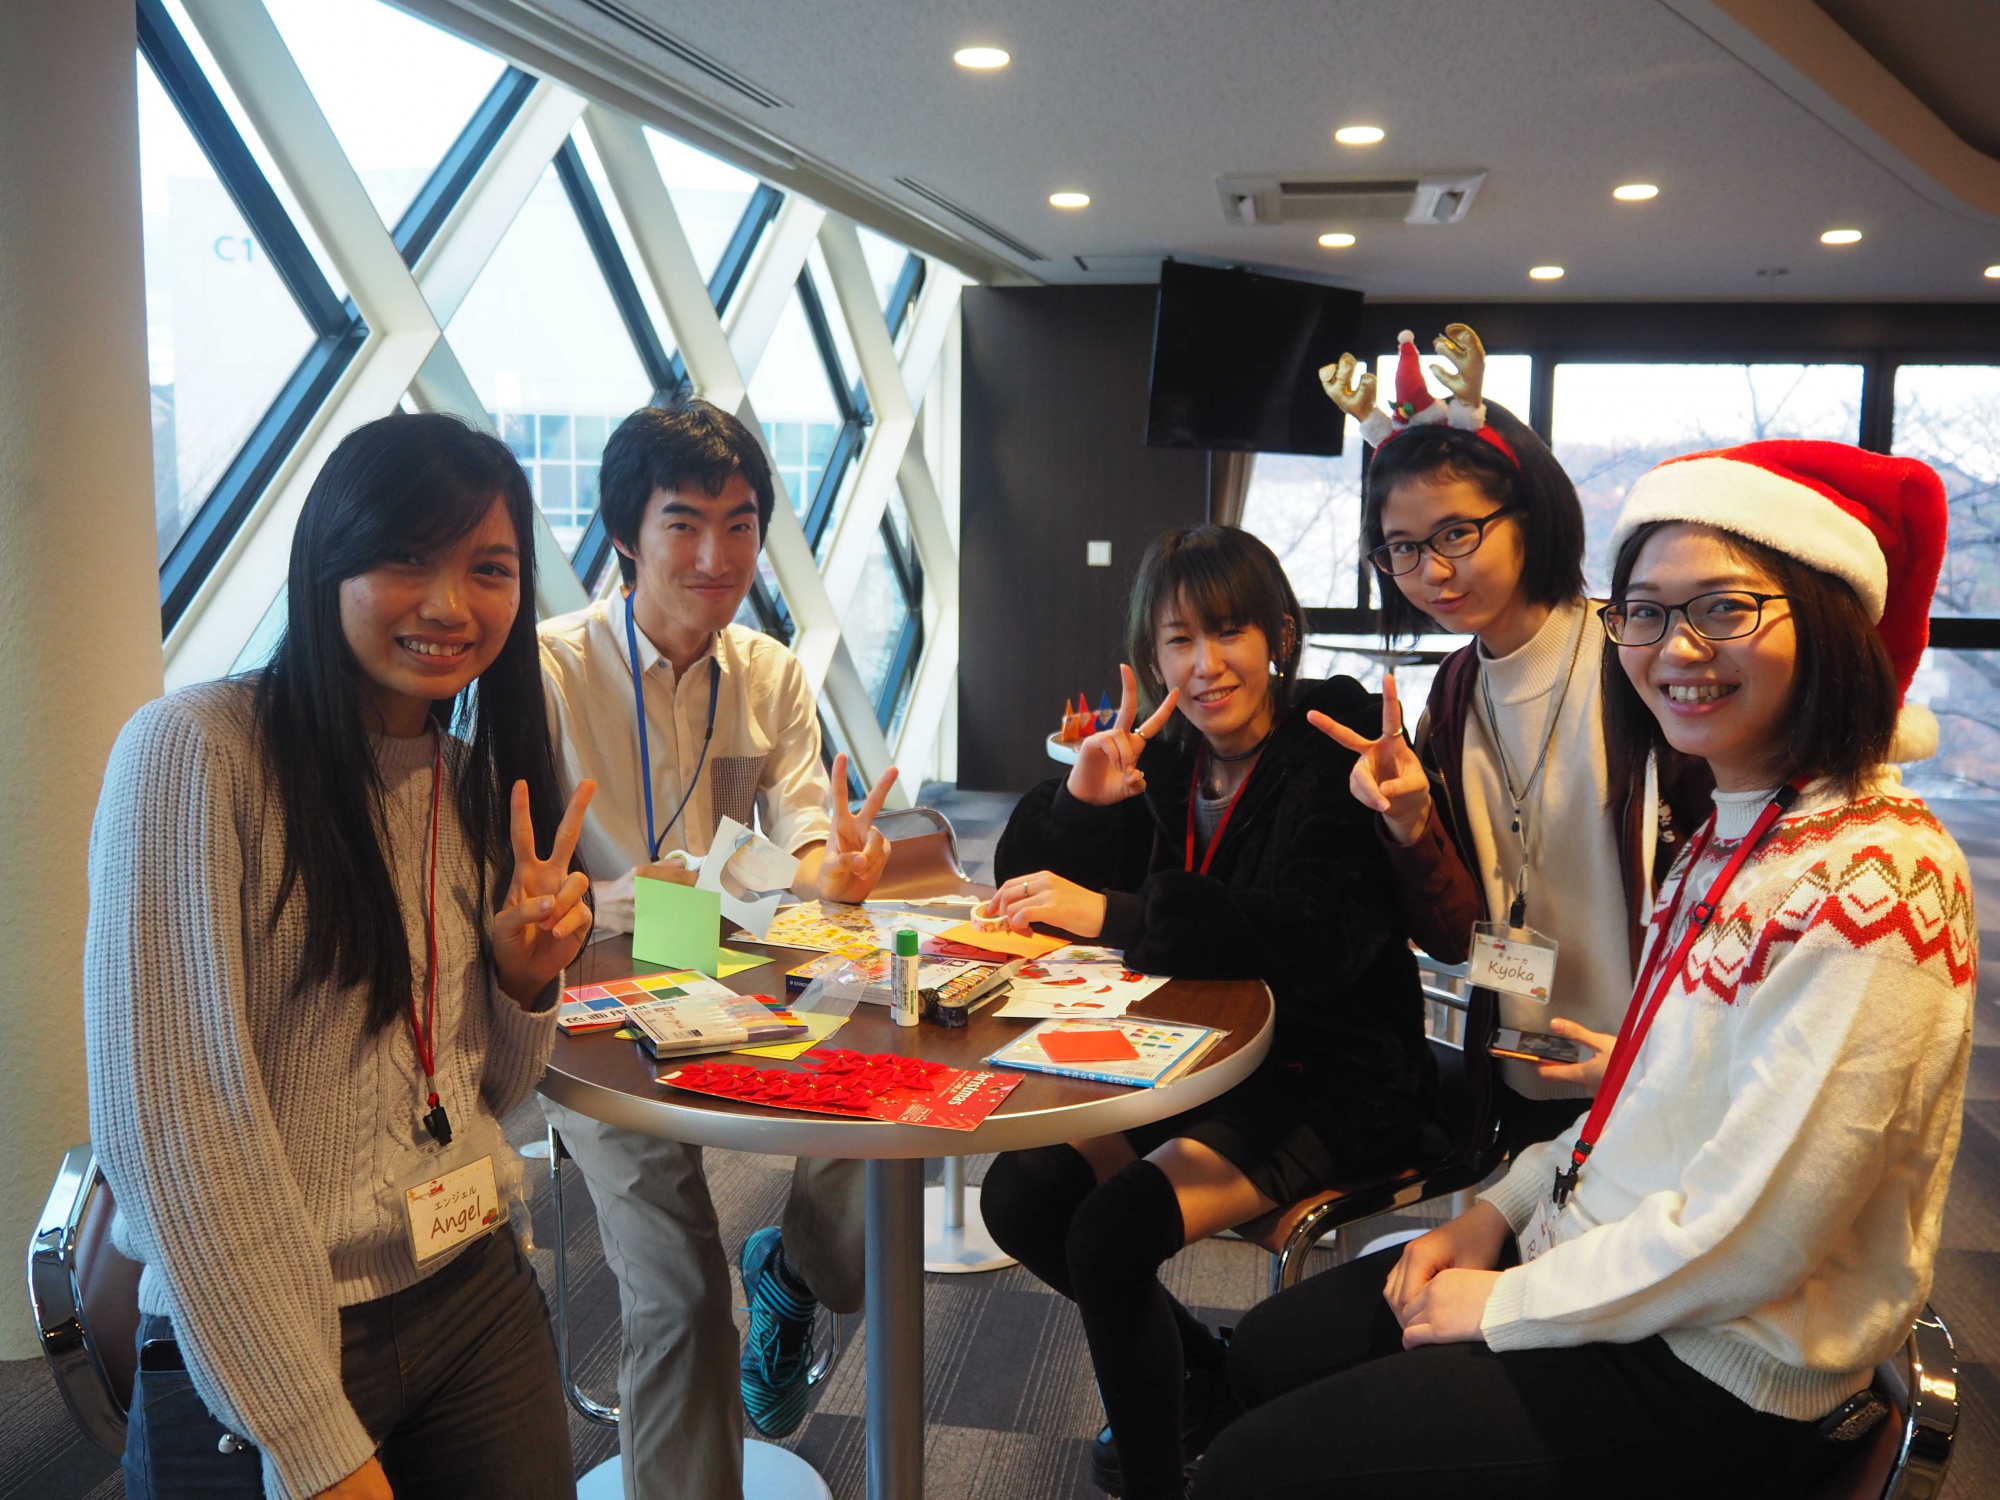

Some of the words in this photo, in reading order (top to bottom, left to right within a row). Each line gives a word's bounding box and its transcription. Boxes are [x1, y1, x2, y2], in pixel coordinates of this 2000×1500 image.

[213, 235, 253, 262] C1
[1488, 960, 1535, 982] Kyoka
[434, 1185, 477, 1211] エンジェル
[430, 1195, 481, 1240] Angel
